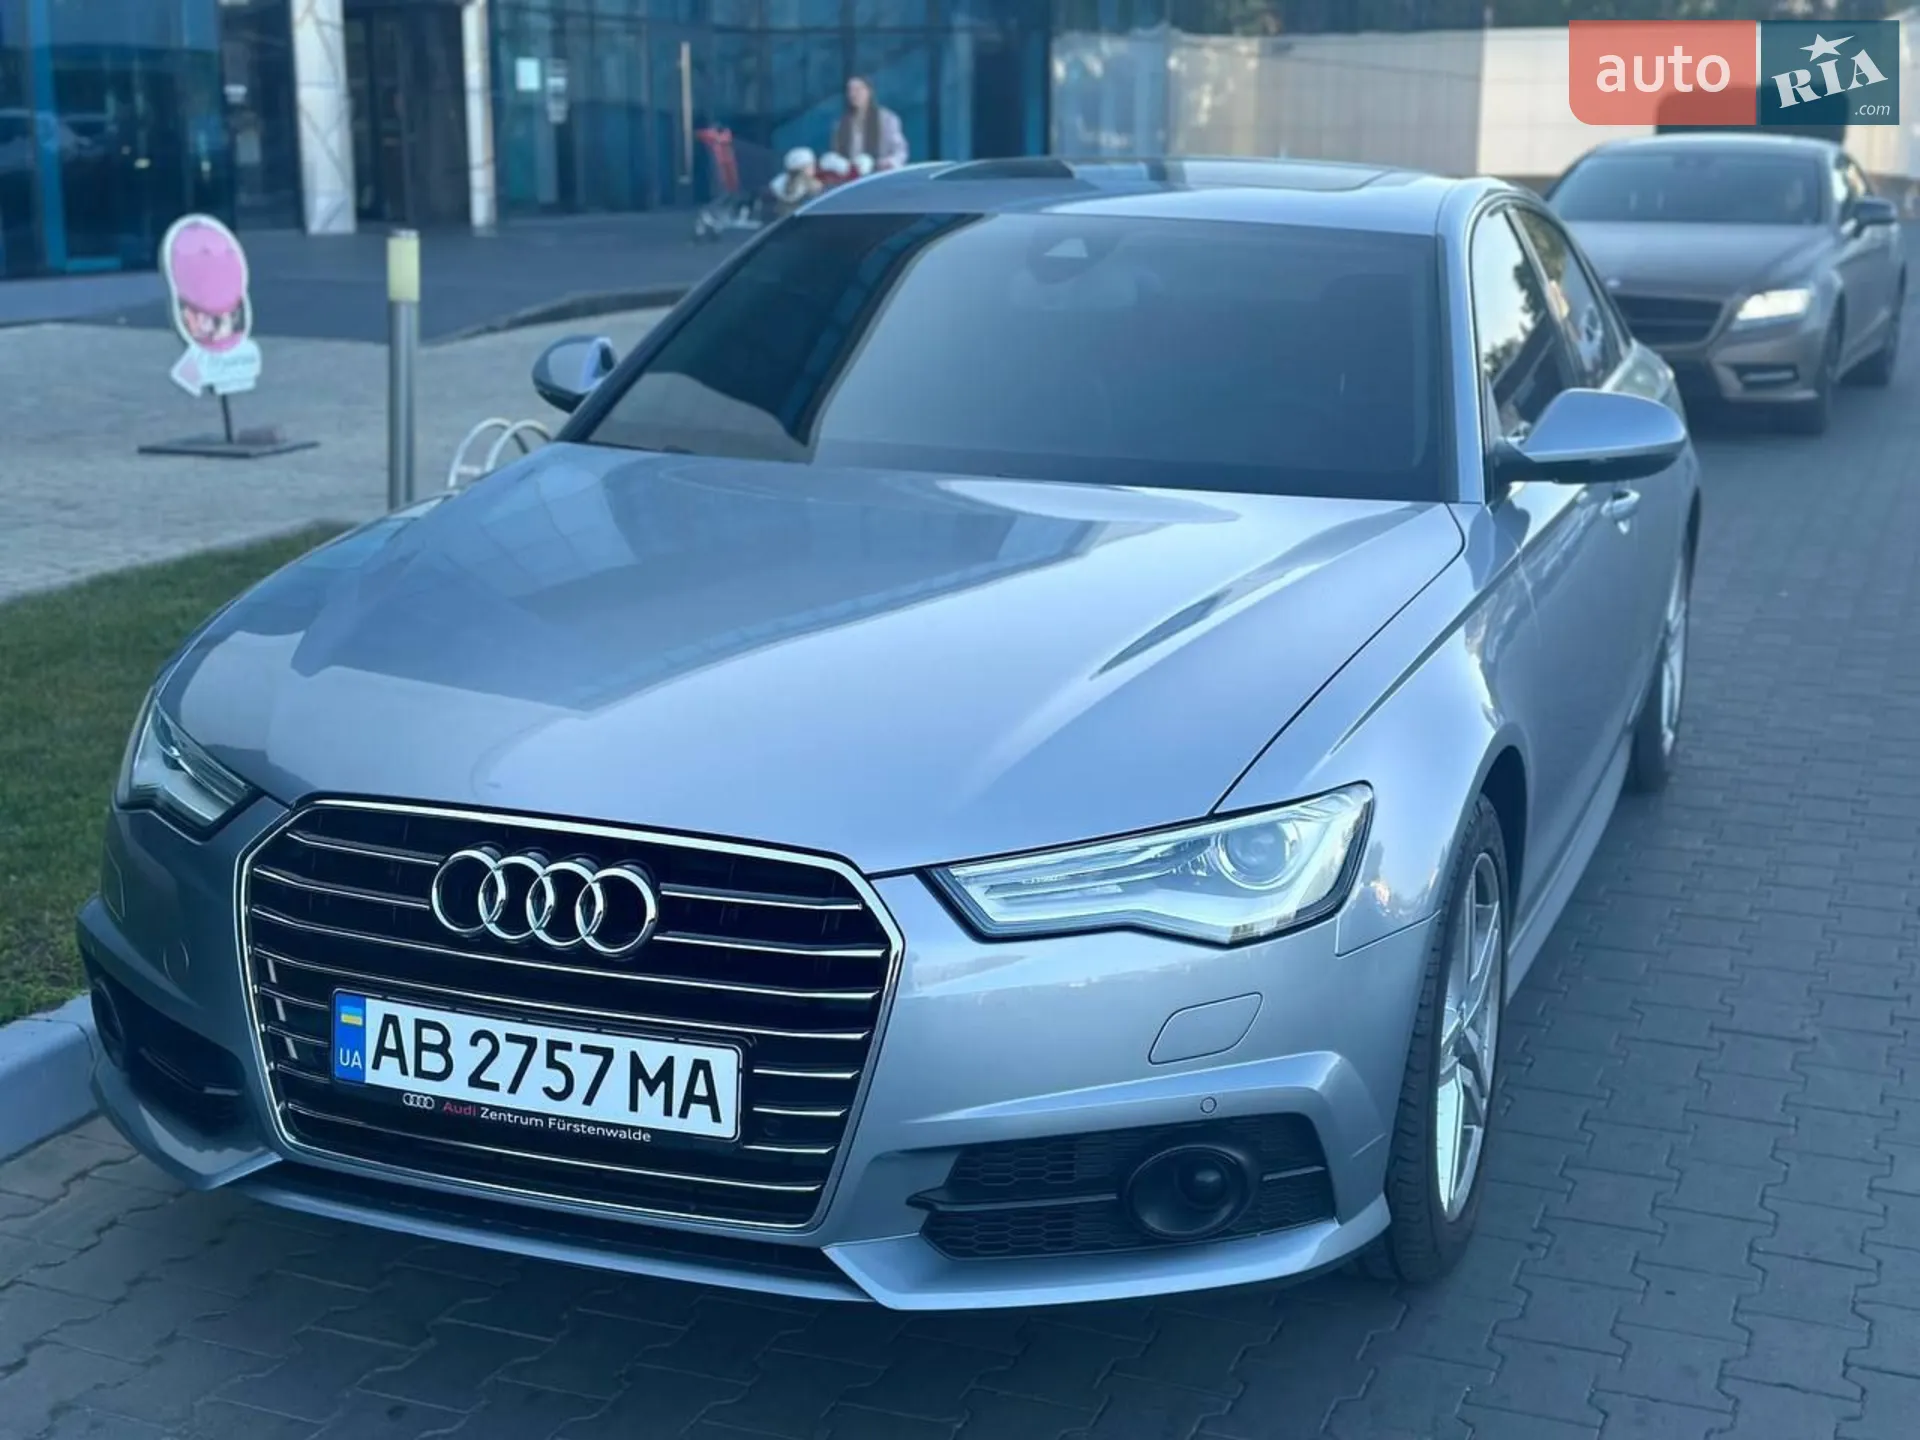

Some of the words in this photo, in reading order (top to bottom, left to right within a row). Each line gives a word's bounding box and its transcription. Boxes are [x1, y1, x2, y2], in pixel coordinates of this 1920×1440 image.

[339, 1047, 363, 1070] UA
[371, 1013, 454, 1082] AB
[467, 1029, 615, 1107] 2757
[628, 1050, 722, 1124] MA
[443, 1102, 476, 1117] Audi
[480, 1107, 544, 1128] Zentrum
[548, 1117, 652, 1143] Fürstenwalde
